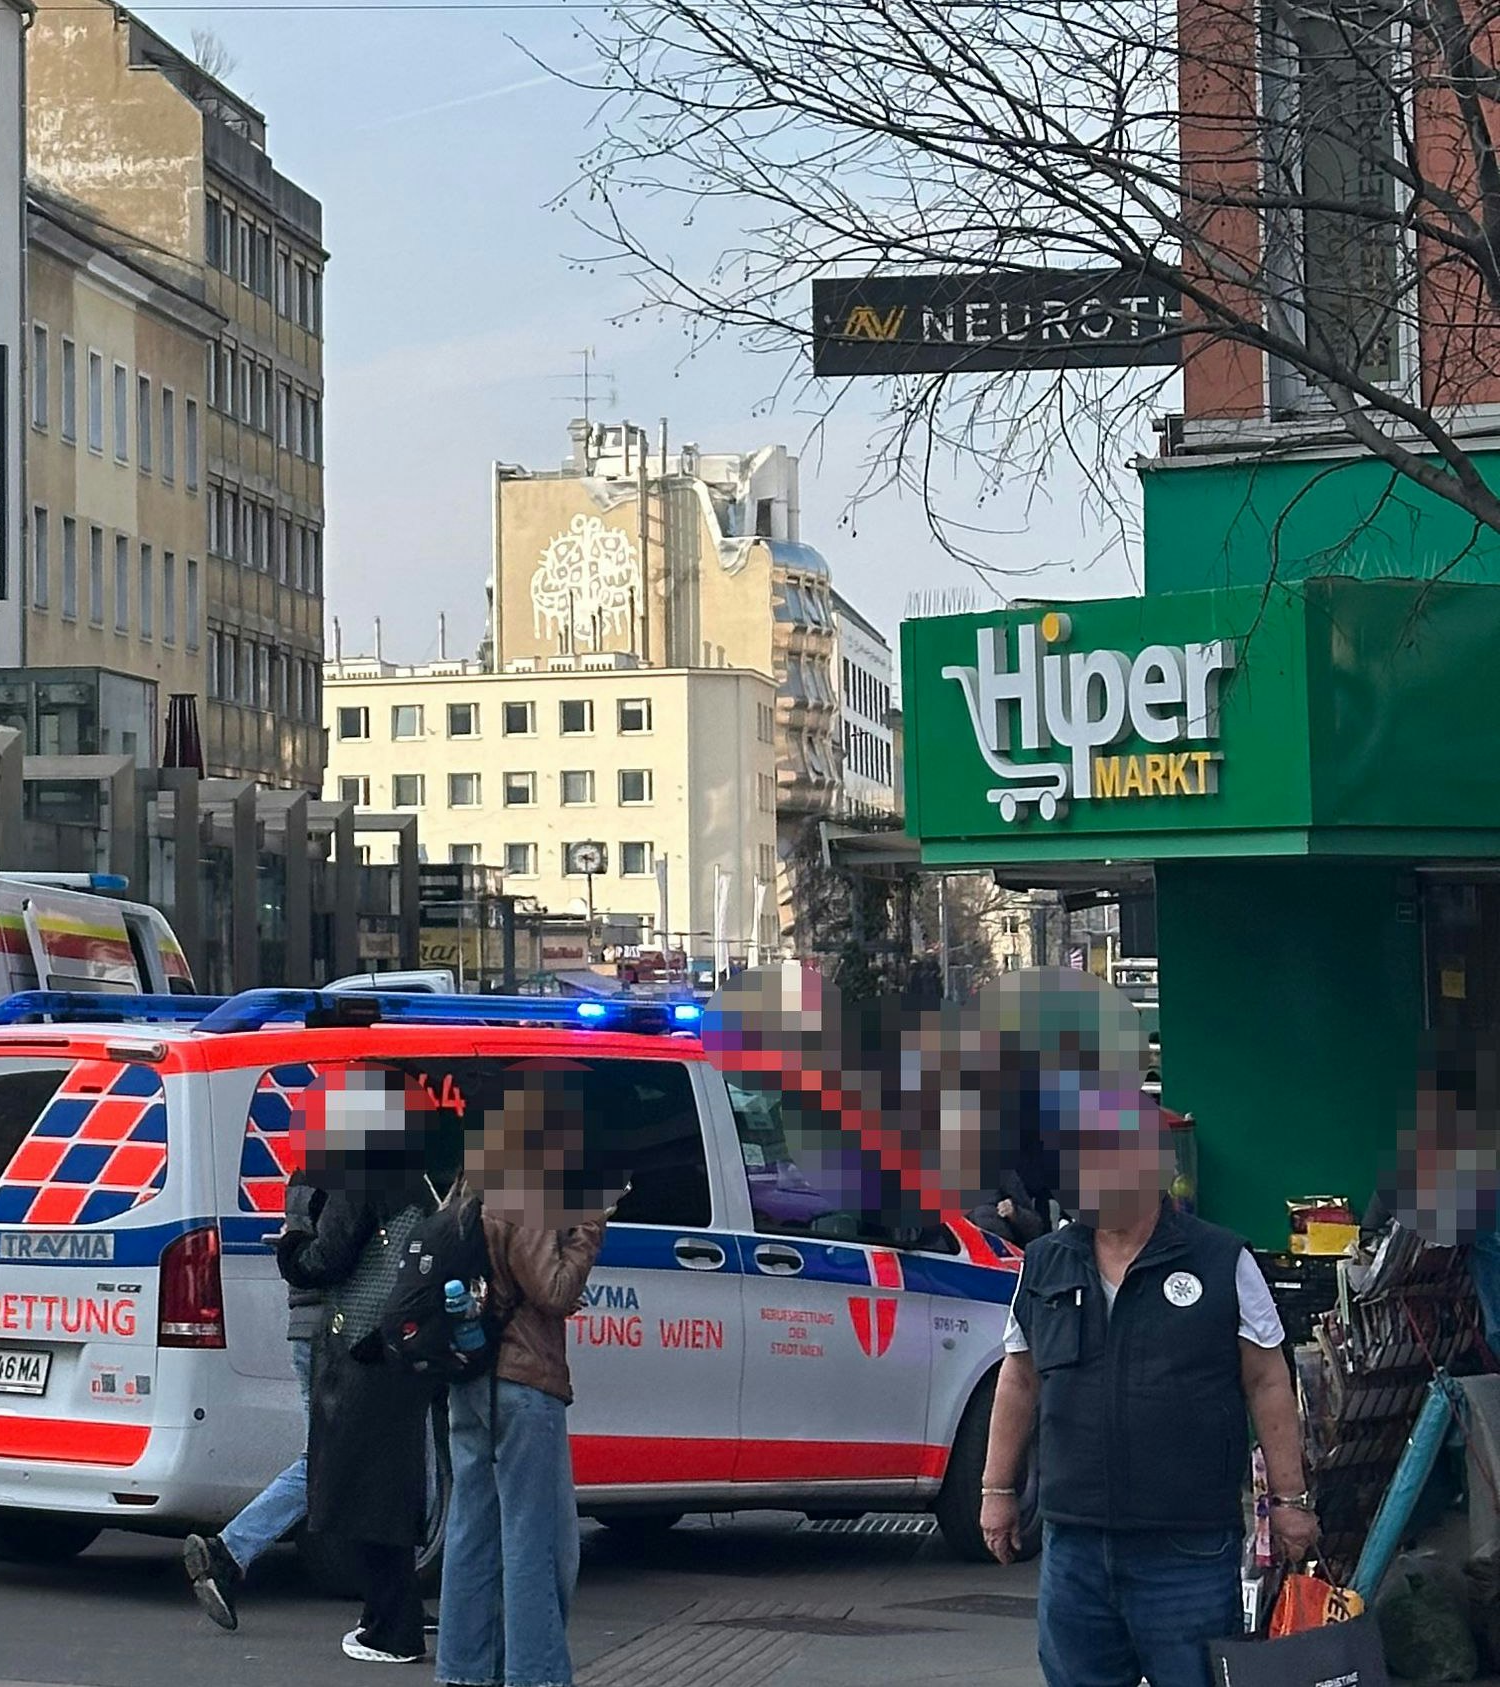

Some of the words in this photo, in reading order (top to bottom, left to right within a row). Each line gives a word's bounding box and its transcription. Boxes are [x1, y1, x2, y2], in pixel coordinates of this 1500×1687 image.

[976, 612, 1230, 799] Hiper
[1095, 752, 1216, 798] MARKT
[660, 1318, 723, 1350] WIEN
[18, 1358, 40, 1382] MA
